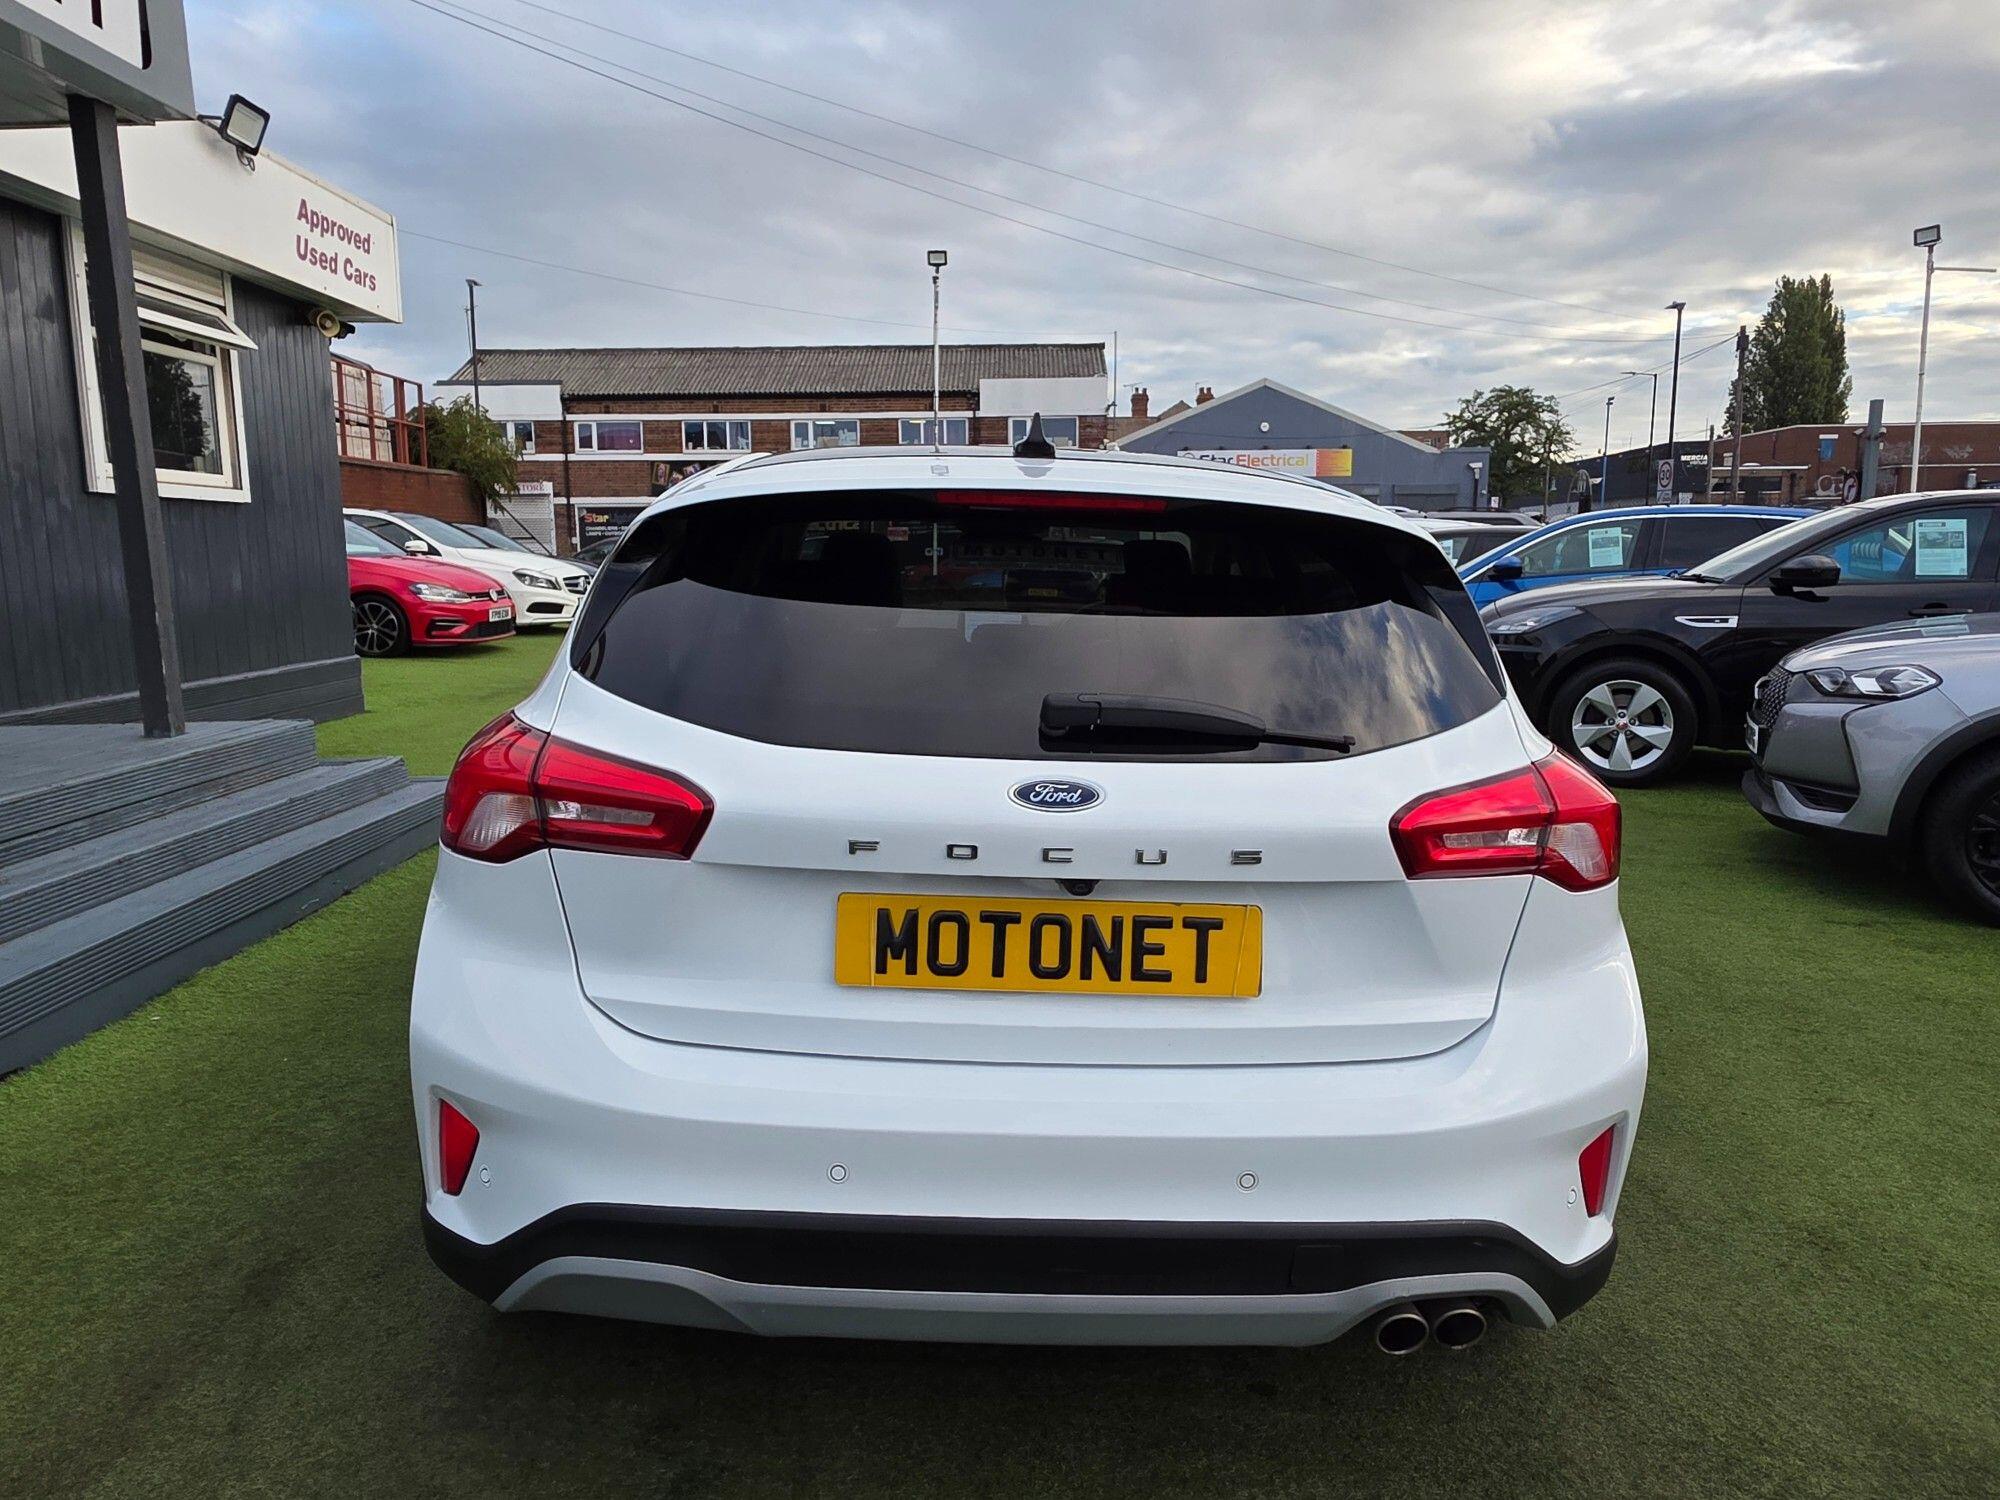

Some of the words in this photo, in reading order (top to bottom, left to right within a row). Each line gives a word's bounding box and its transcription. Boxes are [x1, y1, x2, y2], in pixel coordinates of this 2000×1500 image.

[296, 198, 371, 255] Approved
[296, 234, 338, 275] Used
[343, 257, 376, 292] Cars
[1236, 453, 1309, 467] Electrical
[1660, 469, 1670, 481] 30
[584, 513, 610, 523] Star
[1029, 783, 1082, 803] Ford
[848, 839, 1263, 865] FOCUS
[875, 907, 1224, 984] MOTONET
